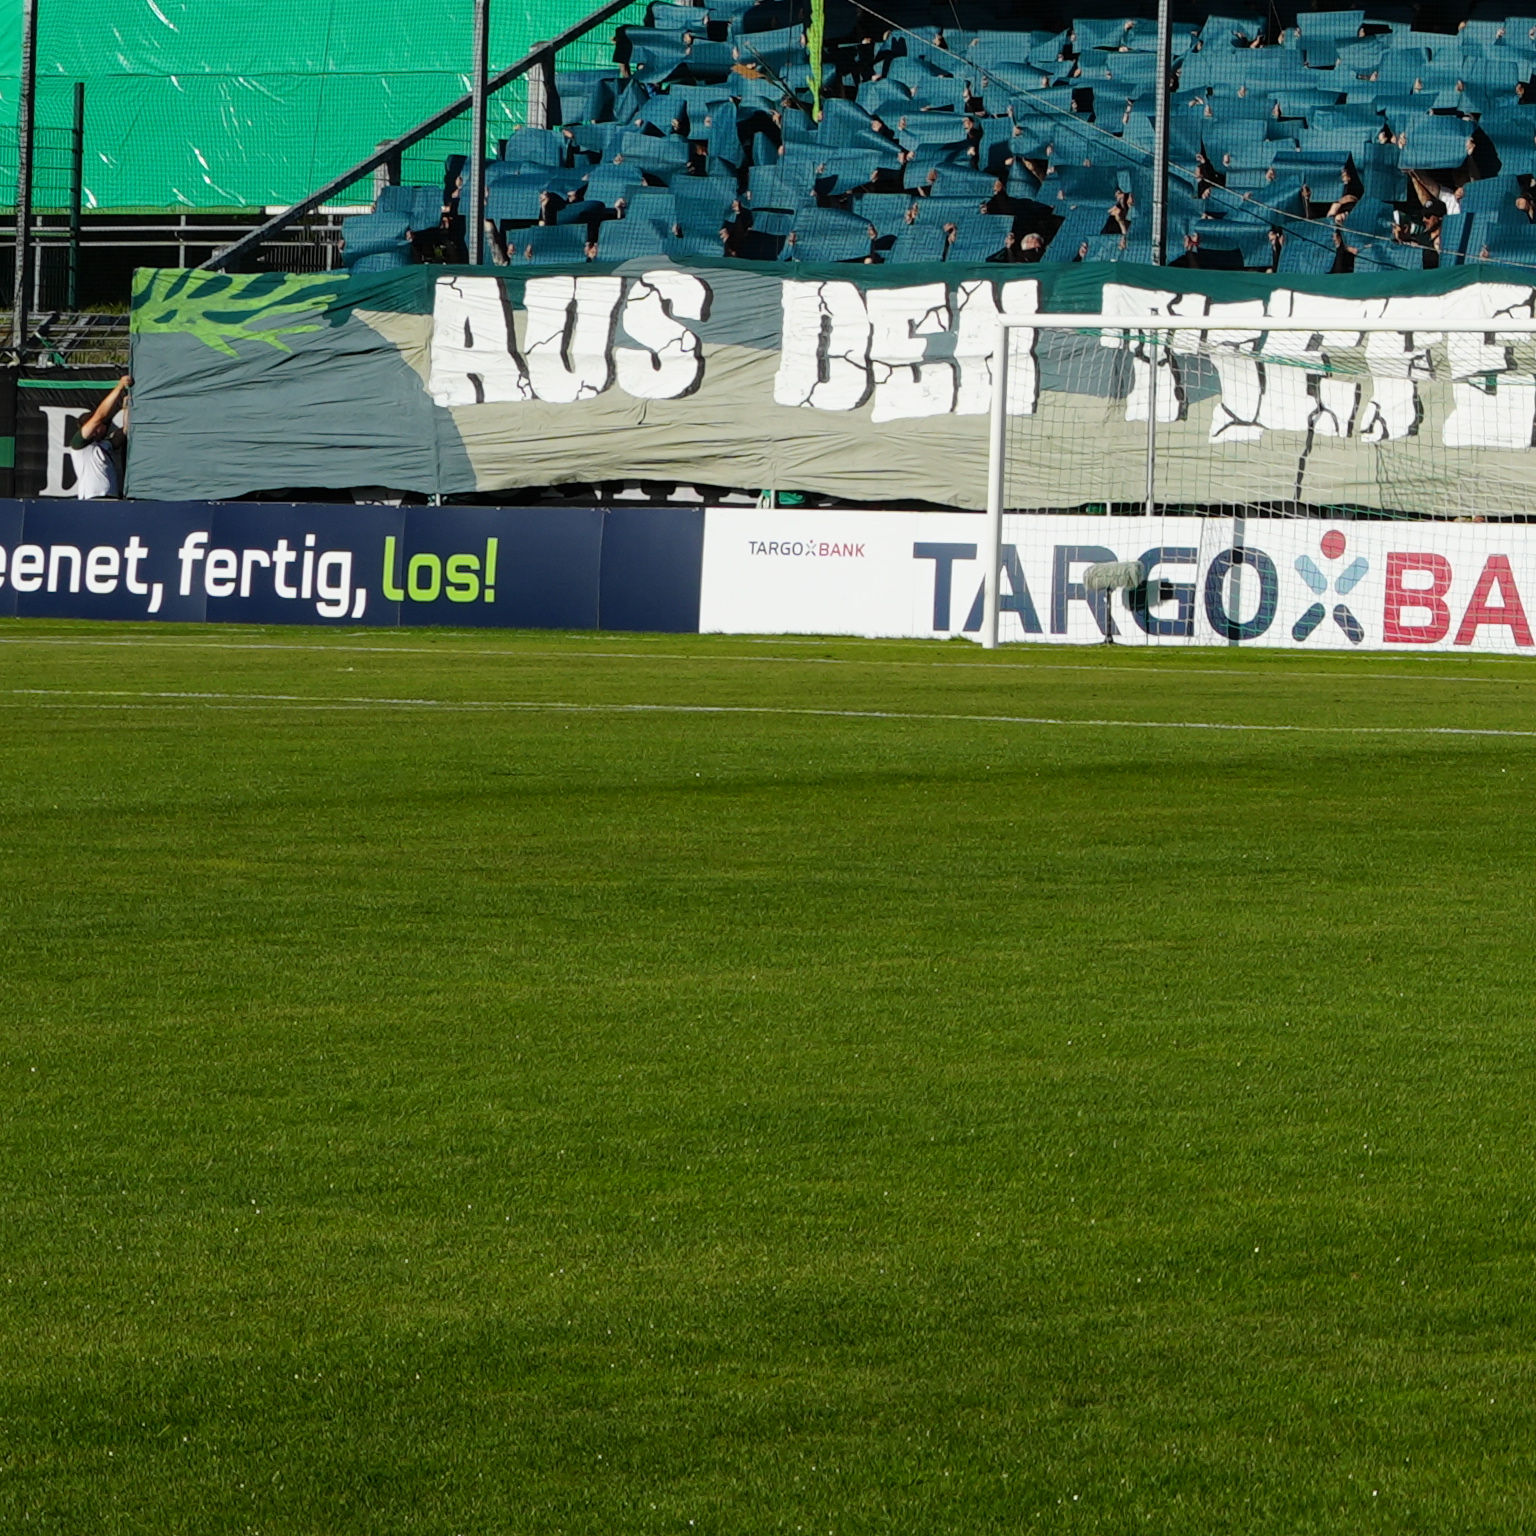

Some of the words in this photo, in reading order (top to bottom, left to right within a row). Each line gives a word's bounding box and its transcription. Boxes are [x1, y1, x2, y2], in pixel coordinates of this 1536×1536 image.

[430, 270, 711, 407] AUS
[774, 278, 1042, 423] DEN
[0, 544, 163, 613] enet,
[179, 531, 367, 619] fertig,
[383, 536, 498, 603] los!
